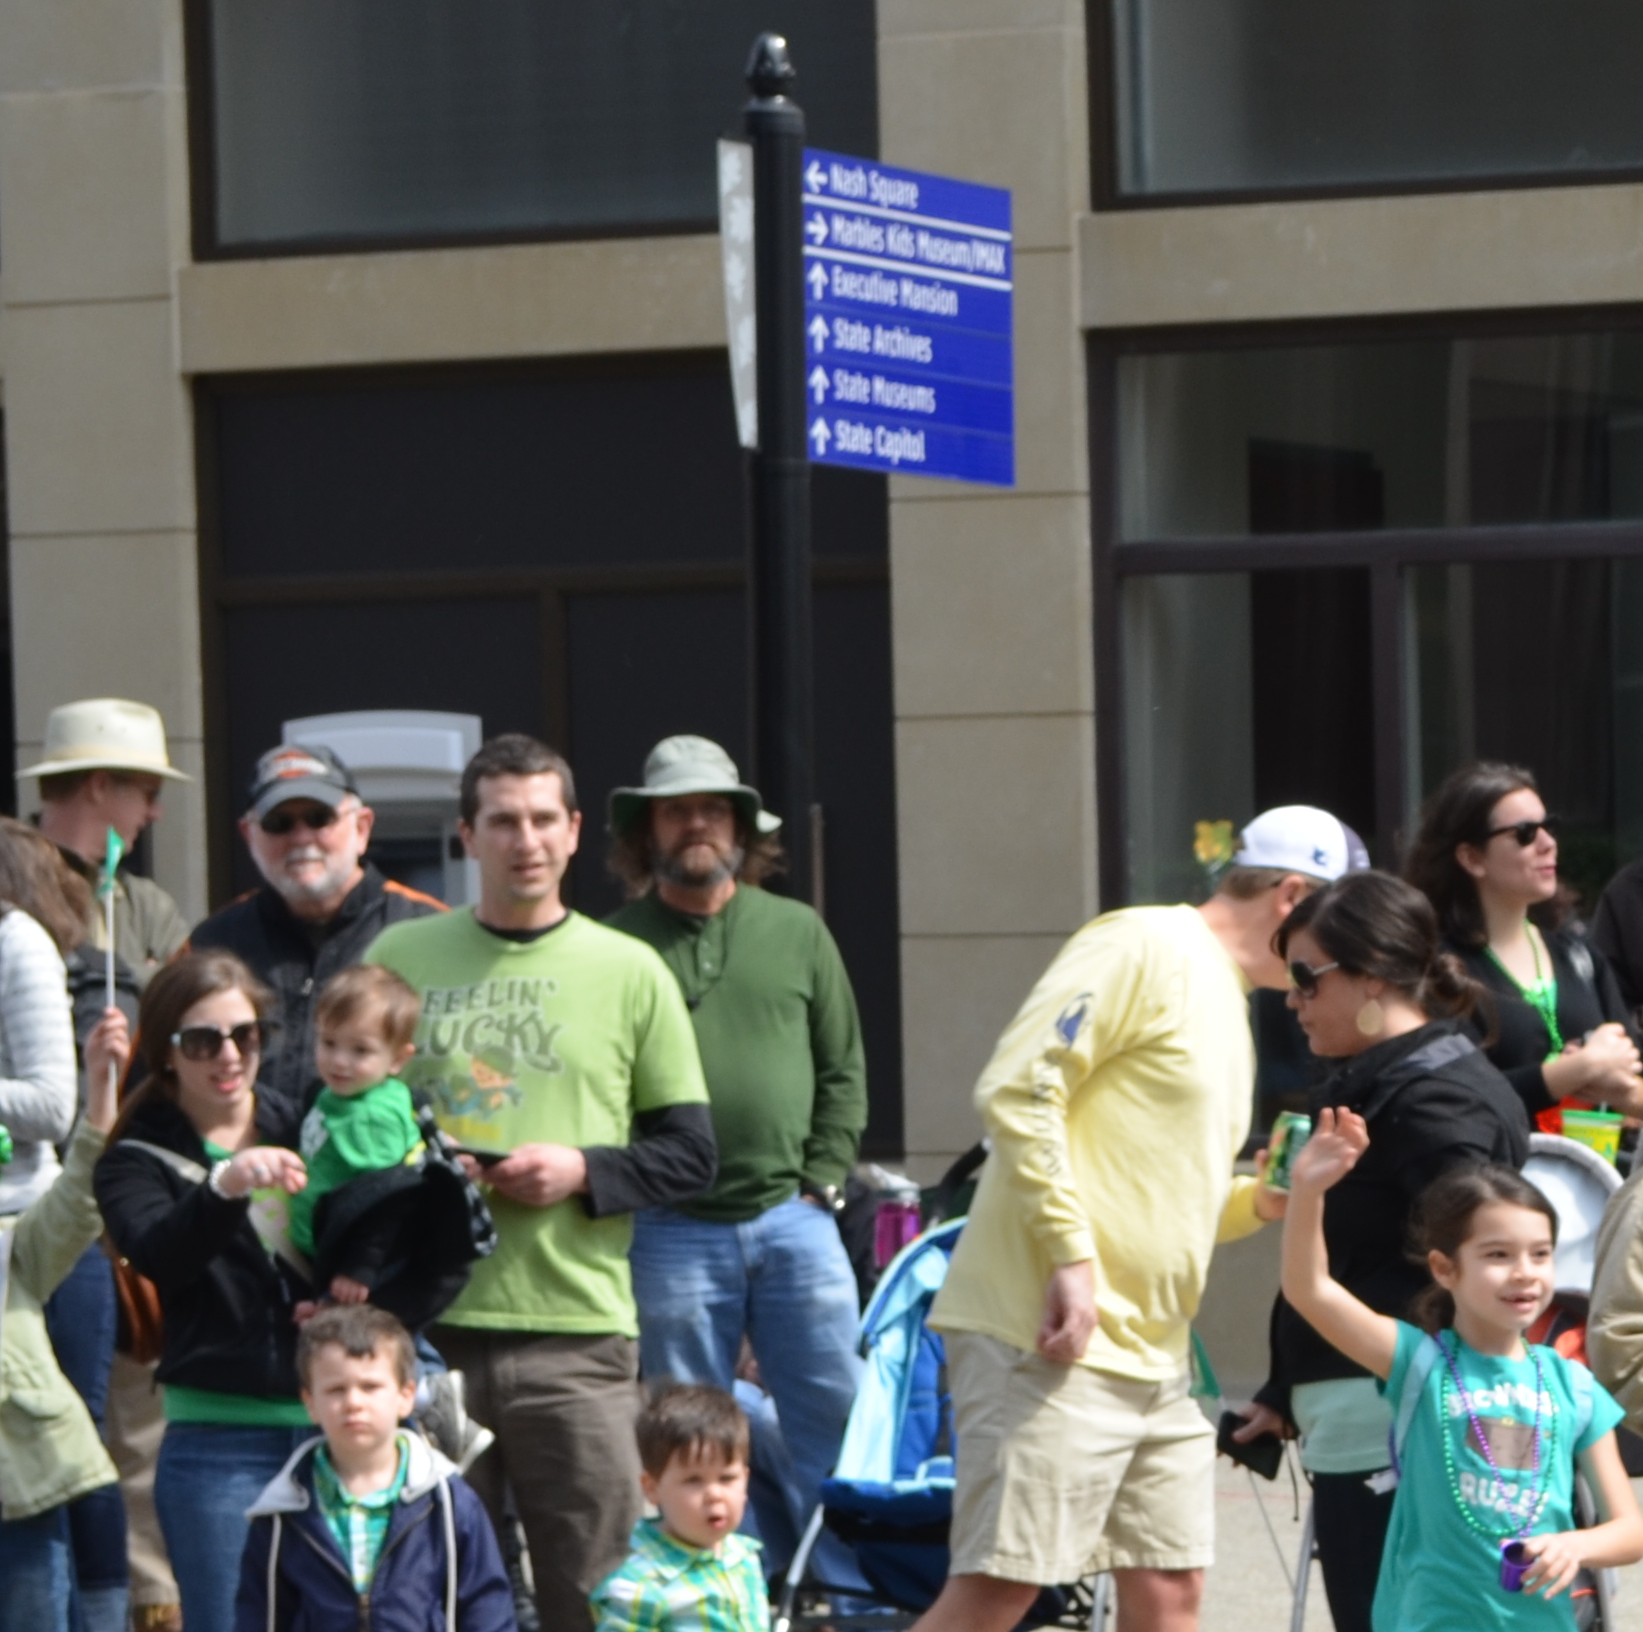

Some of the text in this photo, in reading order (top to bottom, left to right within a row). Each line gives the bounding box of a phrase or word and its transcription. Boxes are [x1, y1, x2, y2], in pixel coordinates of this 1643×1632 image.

[831, 165, 918, 209] Nash Square
[832, 215, 1005, 274] Marbles Kids Museum/IMAX
[832, 266, 958, 316] Executive Mansion
[833, 318, 932, 363] State Archives
[833, 368, 936, 413] State Museums
[834, 419, 925, 465] State Capitol
